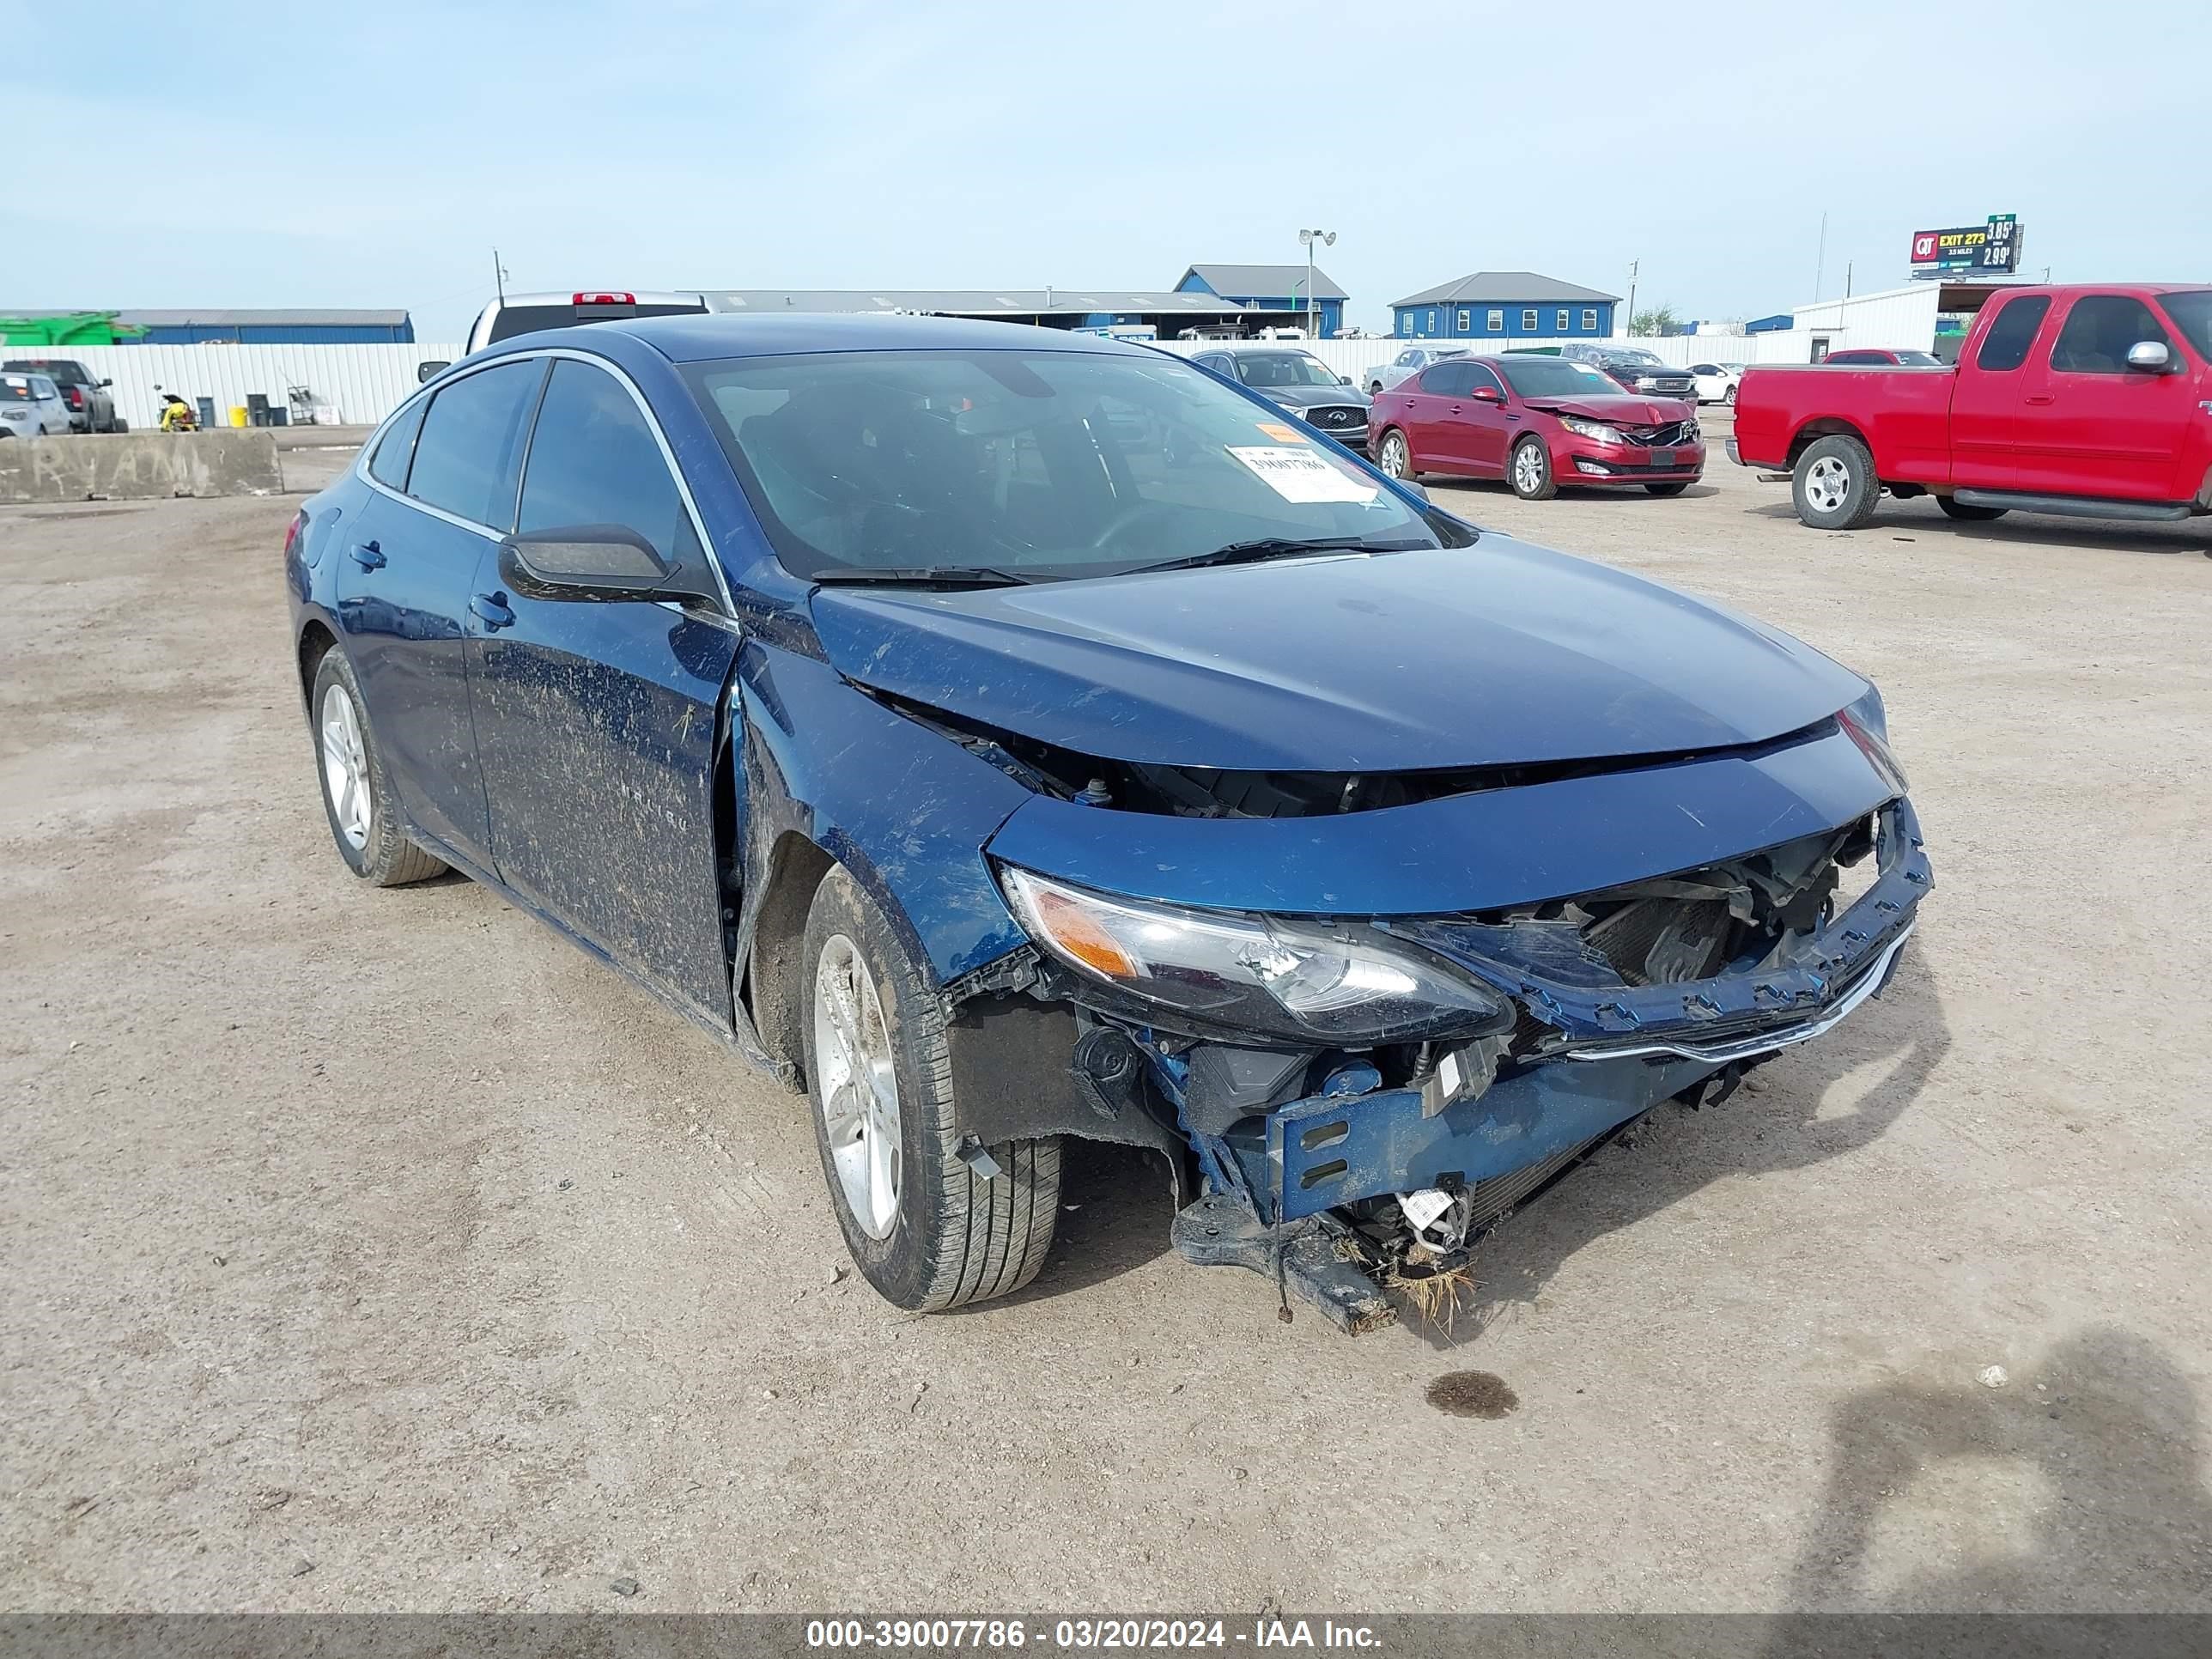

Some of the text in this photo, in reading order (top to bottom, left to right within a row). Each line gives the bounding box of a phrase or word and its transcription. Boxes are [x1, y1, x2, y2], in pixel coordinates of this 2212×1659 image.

[1916, 237, 1935, 256] QT
[1939, 233, 1985, 247] EXIT 273
[1249, 459, 1326, 471] 39007786
